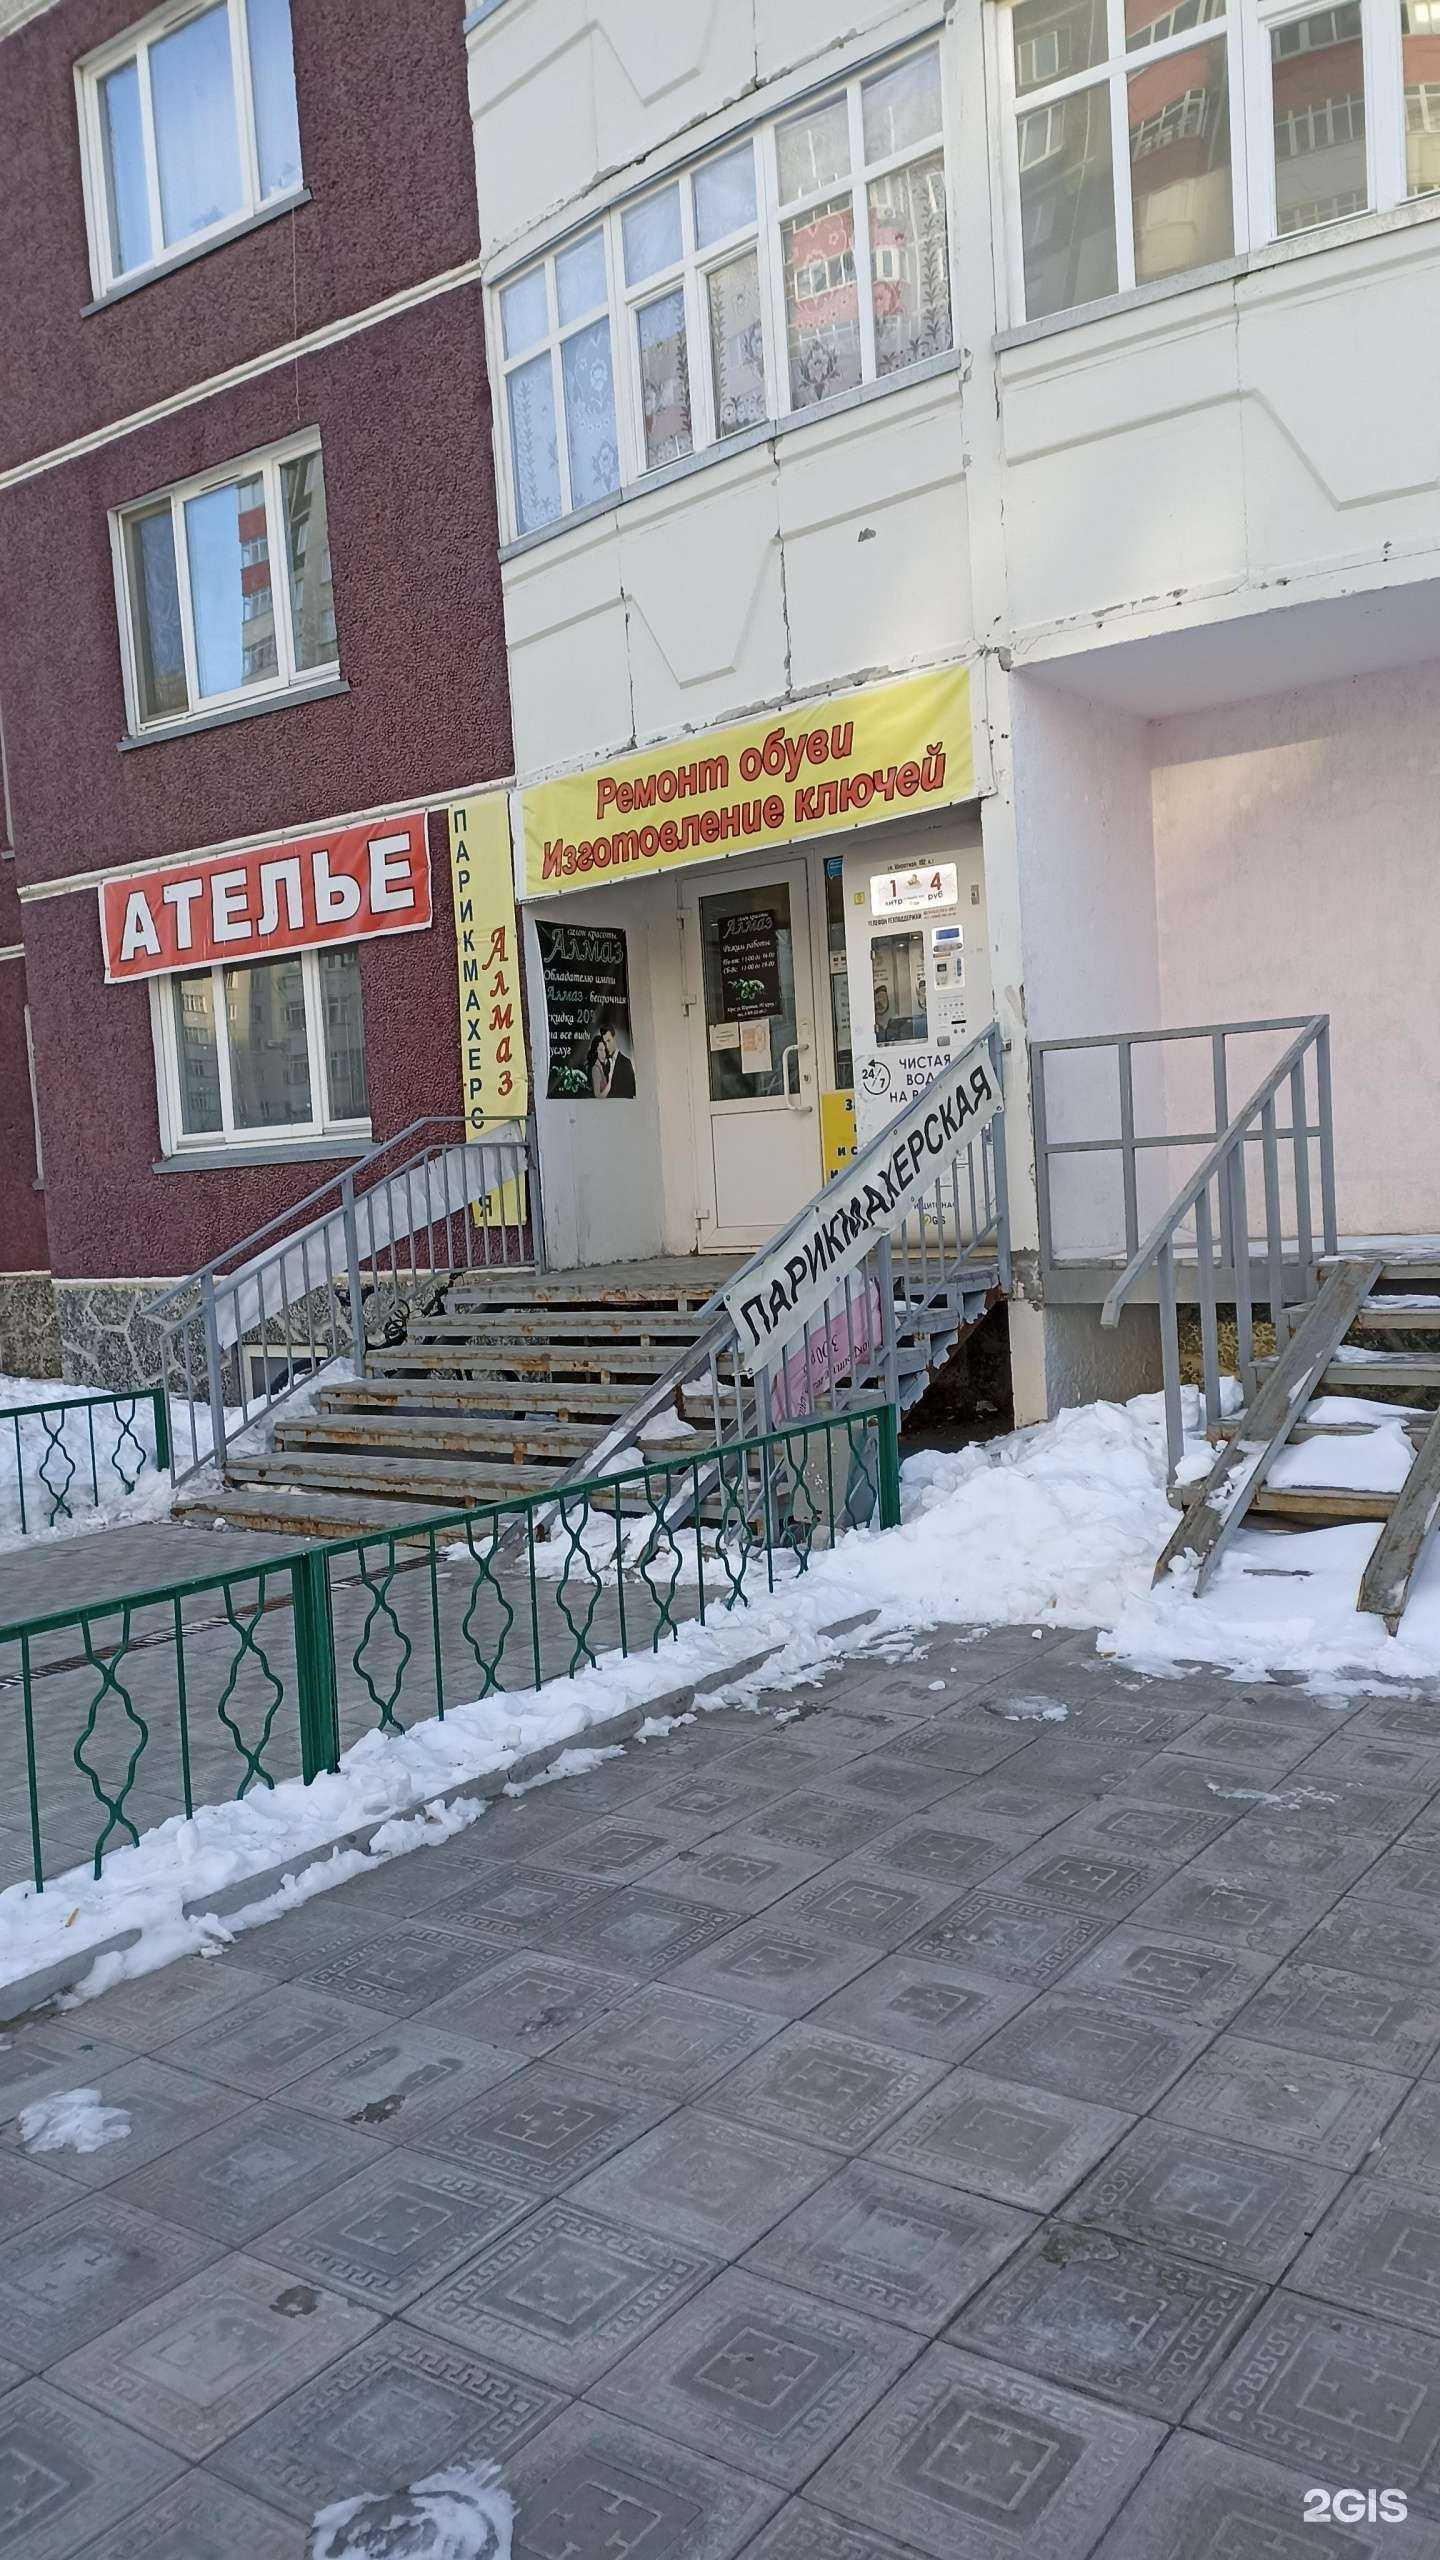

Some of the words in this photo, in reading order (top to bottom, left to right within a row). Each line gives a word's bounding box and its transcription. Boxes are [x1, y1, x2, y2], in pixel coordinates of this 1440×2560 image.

[596, 753, 729, 820] Ремонт
[739, 721, 854, 782] обуви
[541, 795, 785, 880] Изготовление
[794, 741, 946, 824] ключей
[890, 879, 897, 898] 1
[930, 872, 942, 891] 4
[928, 890, 943, 901] руб
[119, 833, 415, 962] АТЕЛЬЕ
[722, 916, 773, 939] Алмаз
[544, 928, 624, 964] Алмаз
[544, 969, 594, 984] Обладателю
[546, 986, 583, 1002] Алмаз
[453, 808, 492, 1218] ПАРИКМАХЕРСЯ
[482, 925, 514, 1096] Алмаз
[560, 1031, 572, 1040] все
[899, 1054, 951, 1070] ЧИСТАЯ
[906, 1072, 936, 1086] ВОД
[889, 1091, 908, 1103] НА
[740, 1064, 992, 1347] ПАРИКМАХЕРСКАЯ
